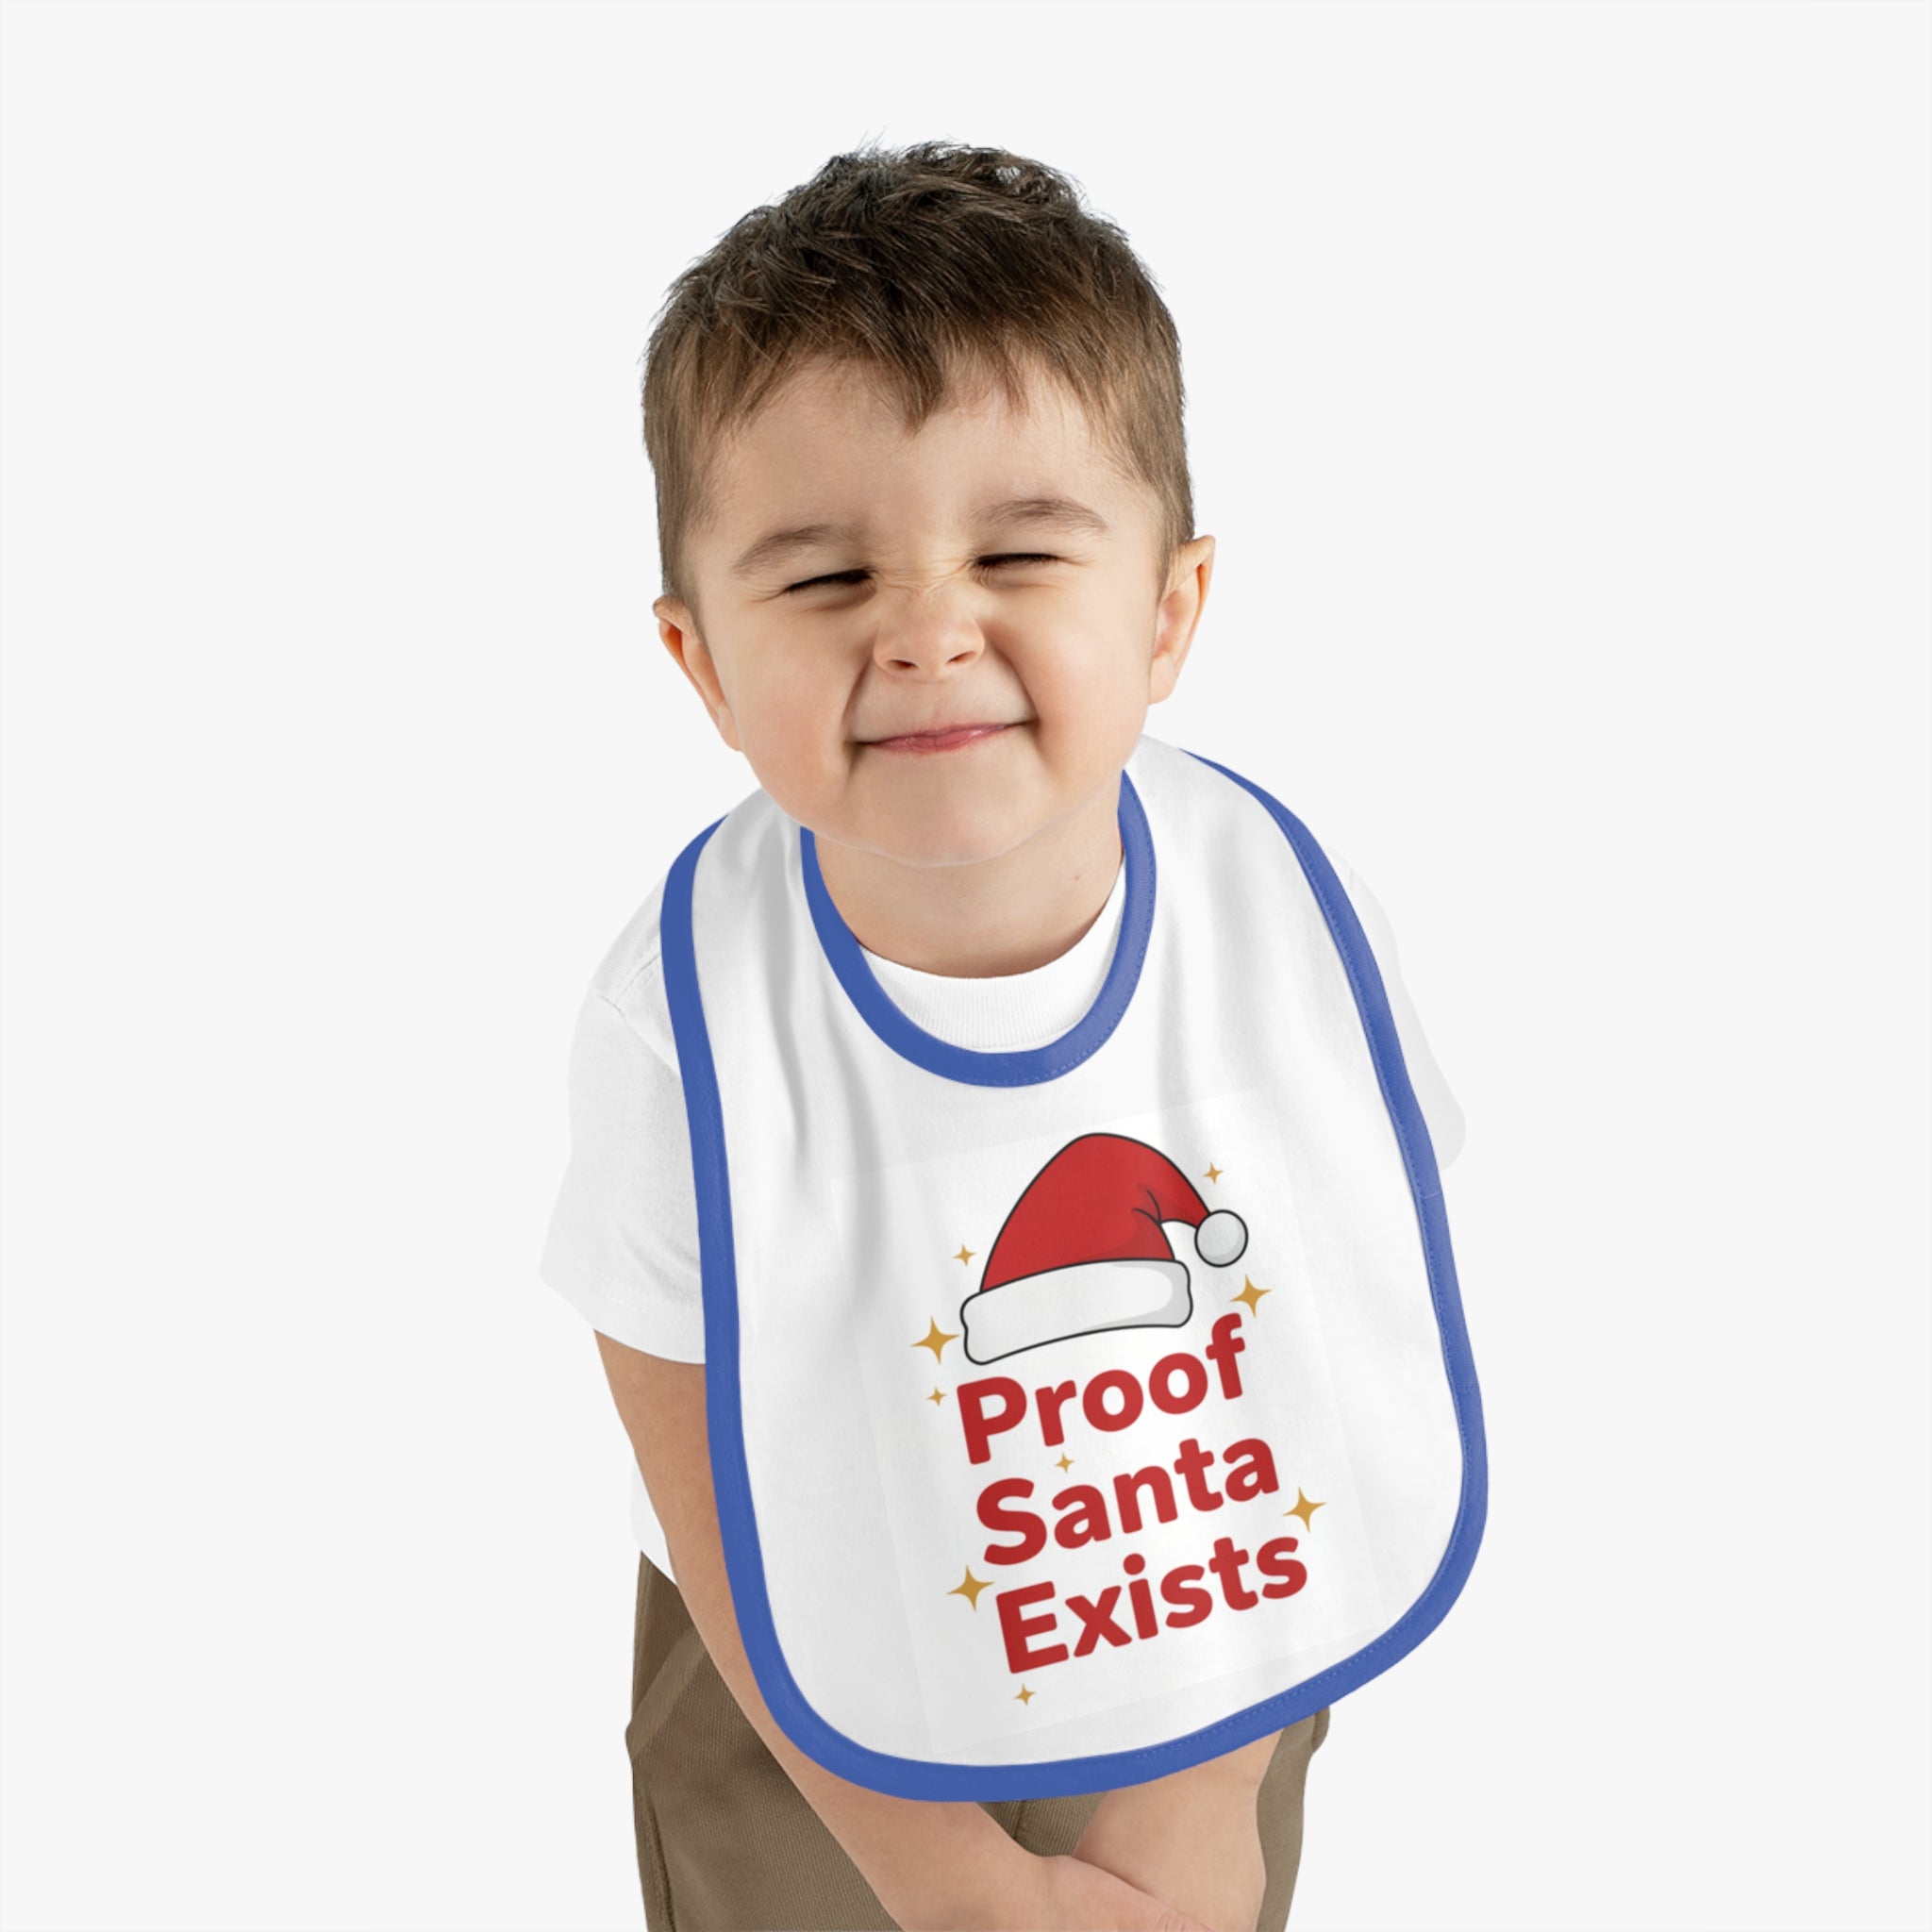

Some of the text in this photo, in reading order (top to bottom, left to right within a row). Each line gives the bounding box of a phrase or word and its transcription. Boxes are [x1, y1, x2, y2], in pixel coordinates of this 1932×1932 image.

[956, 1312, 1247, 1466] Proof
[975, 1438, 1280, 1567] Santa
[995, 1535, 1308, 1674] Exists
